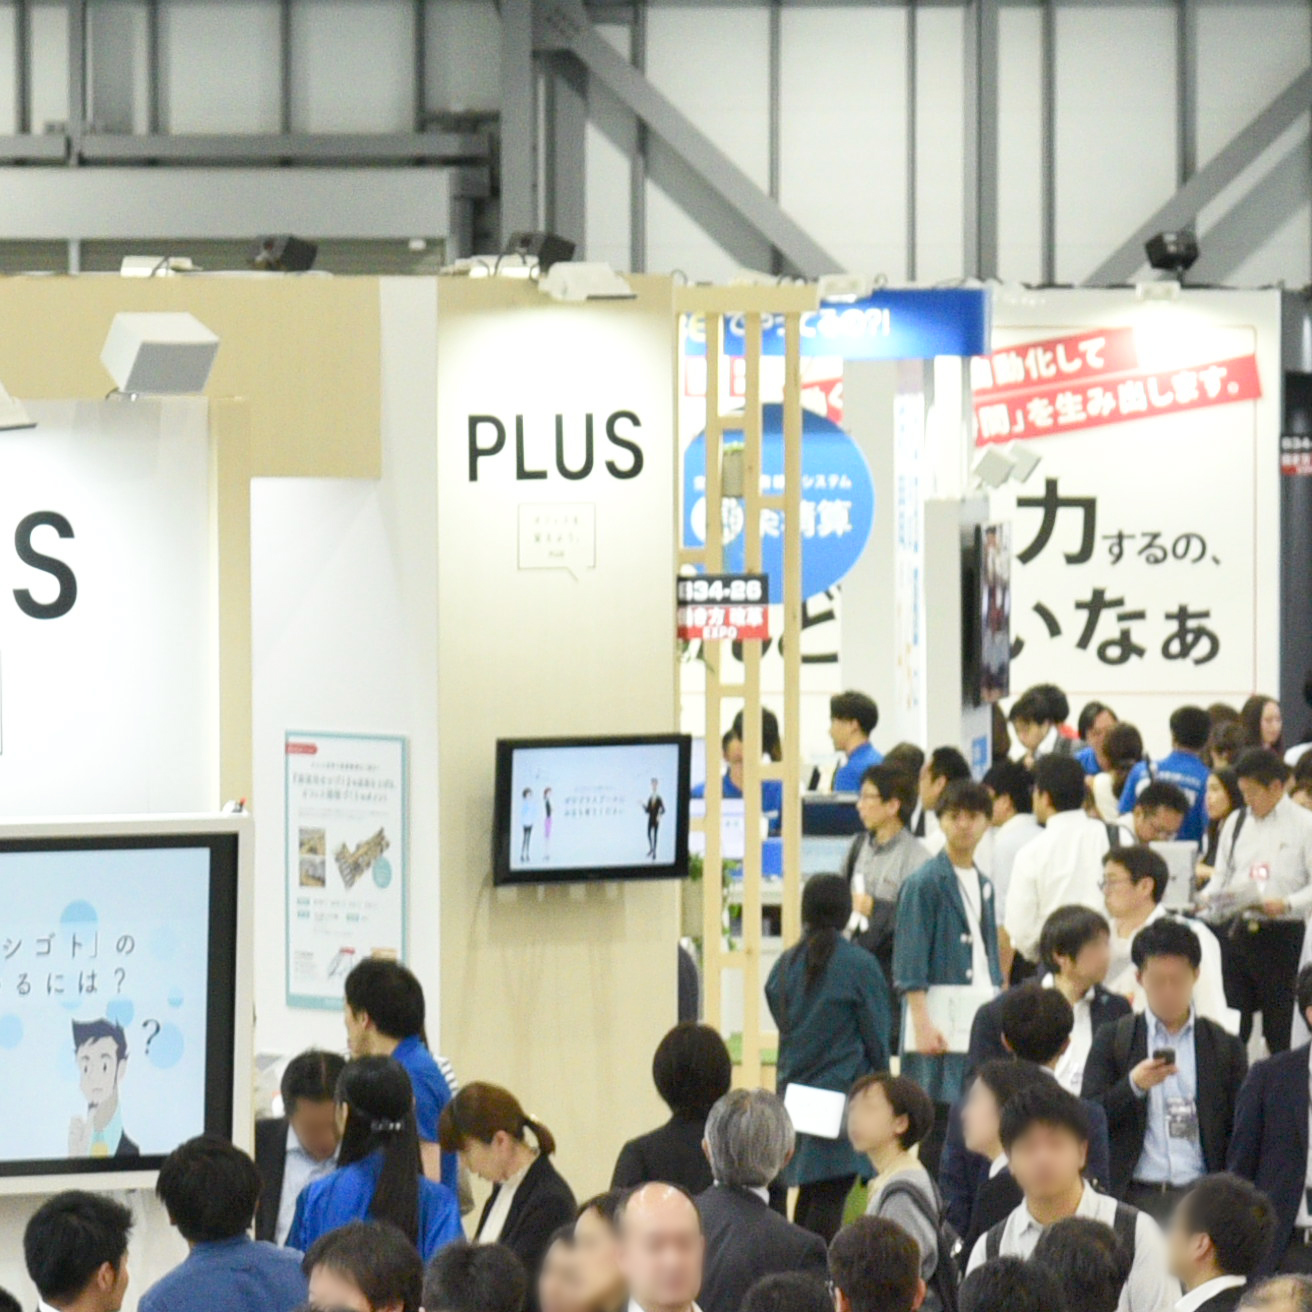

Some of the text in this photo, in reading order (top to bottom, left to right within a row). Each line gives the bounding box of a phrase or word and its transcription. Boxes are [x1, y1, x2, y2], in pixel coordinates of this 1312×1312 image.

[974, 365, 1239, 440] 間」を生み出します。
[467, 410, 645, 483] PLUS
